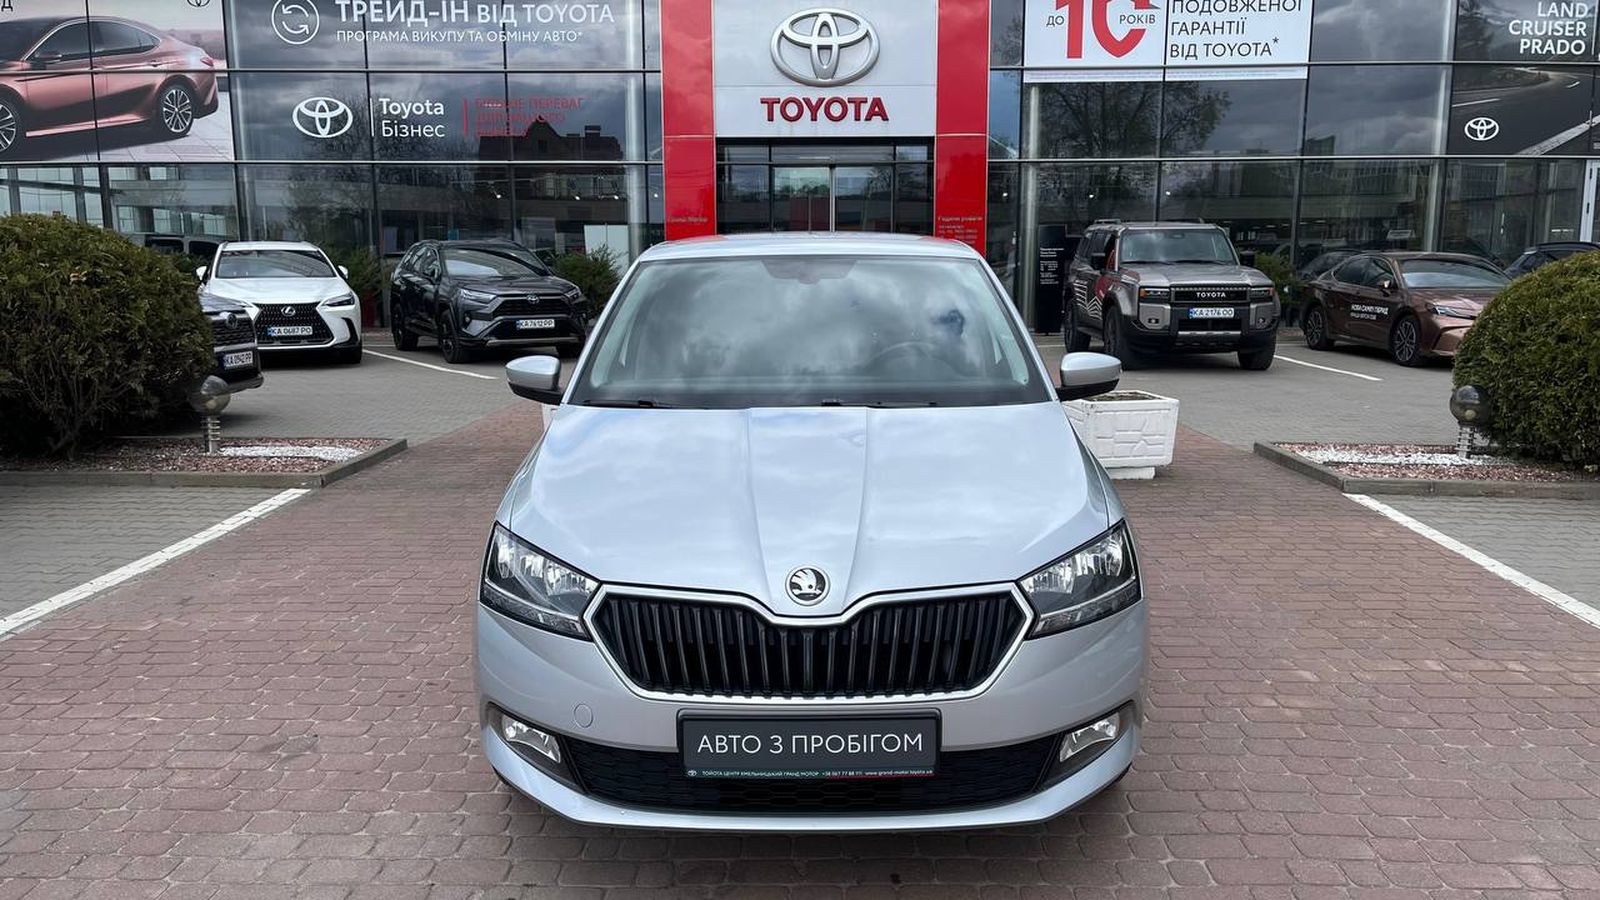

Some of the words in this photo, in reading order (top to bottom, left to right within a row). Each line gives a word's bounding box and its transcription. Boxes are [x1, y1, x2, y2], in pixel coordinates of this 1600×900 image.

[477, 4, 517, 27] ВІД
[522, 4, 615, 23] TOYOTA
[1537, 2, 1588, 18] LAND
[1046, 15, 1066, 27] ДО
[1119, 14, 1156, 24] РОКІВ
[1170, 17, 1247, 35] ГАРАНТІЇ
[1508, 20, 1587, 36] CRUISER
[336, 30, 409, 42] ПРОГРАМА
[411, 30, 468, 42] ВИКУПУ
[469, 30, 484, 42] ТА
[486, 30, 540, 42] ОБМІНУ
[1170, 43, 1198, 60] ВІД
[1519, 38, 1586, 55] PRADO
[378, 98, 444, 118] Toyota
[760, 96, 889, 122] TOYOTA
[382, 120, 445, 137] Бізнес
[300, 326, 312, 334] PO
[697, 734, 762, 754] АВТО
[791, 733, 923, 754] ПРОБІГОМ
